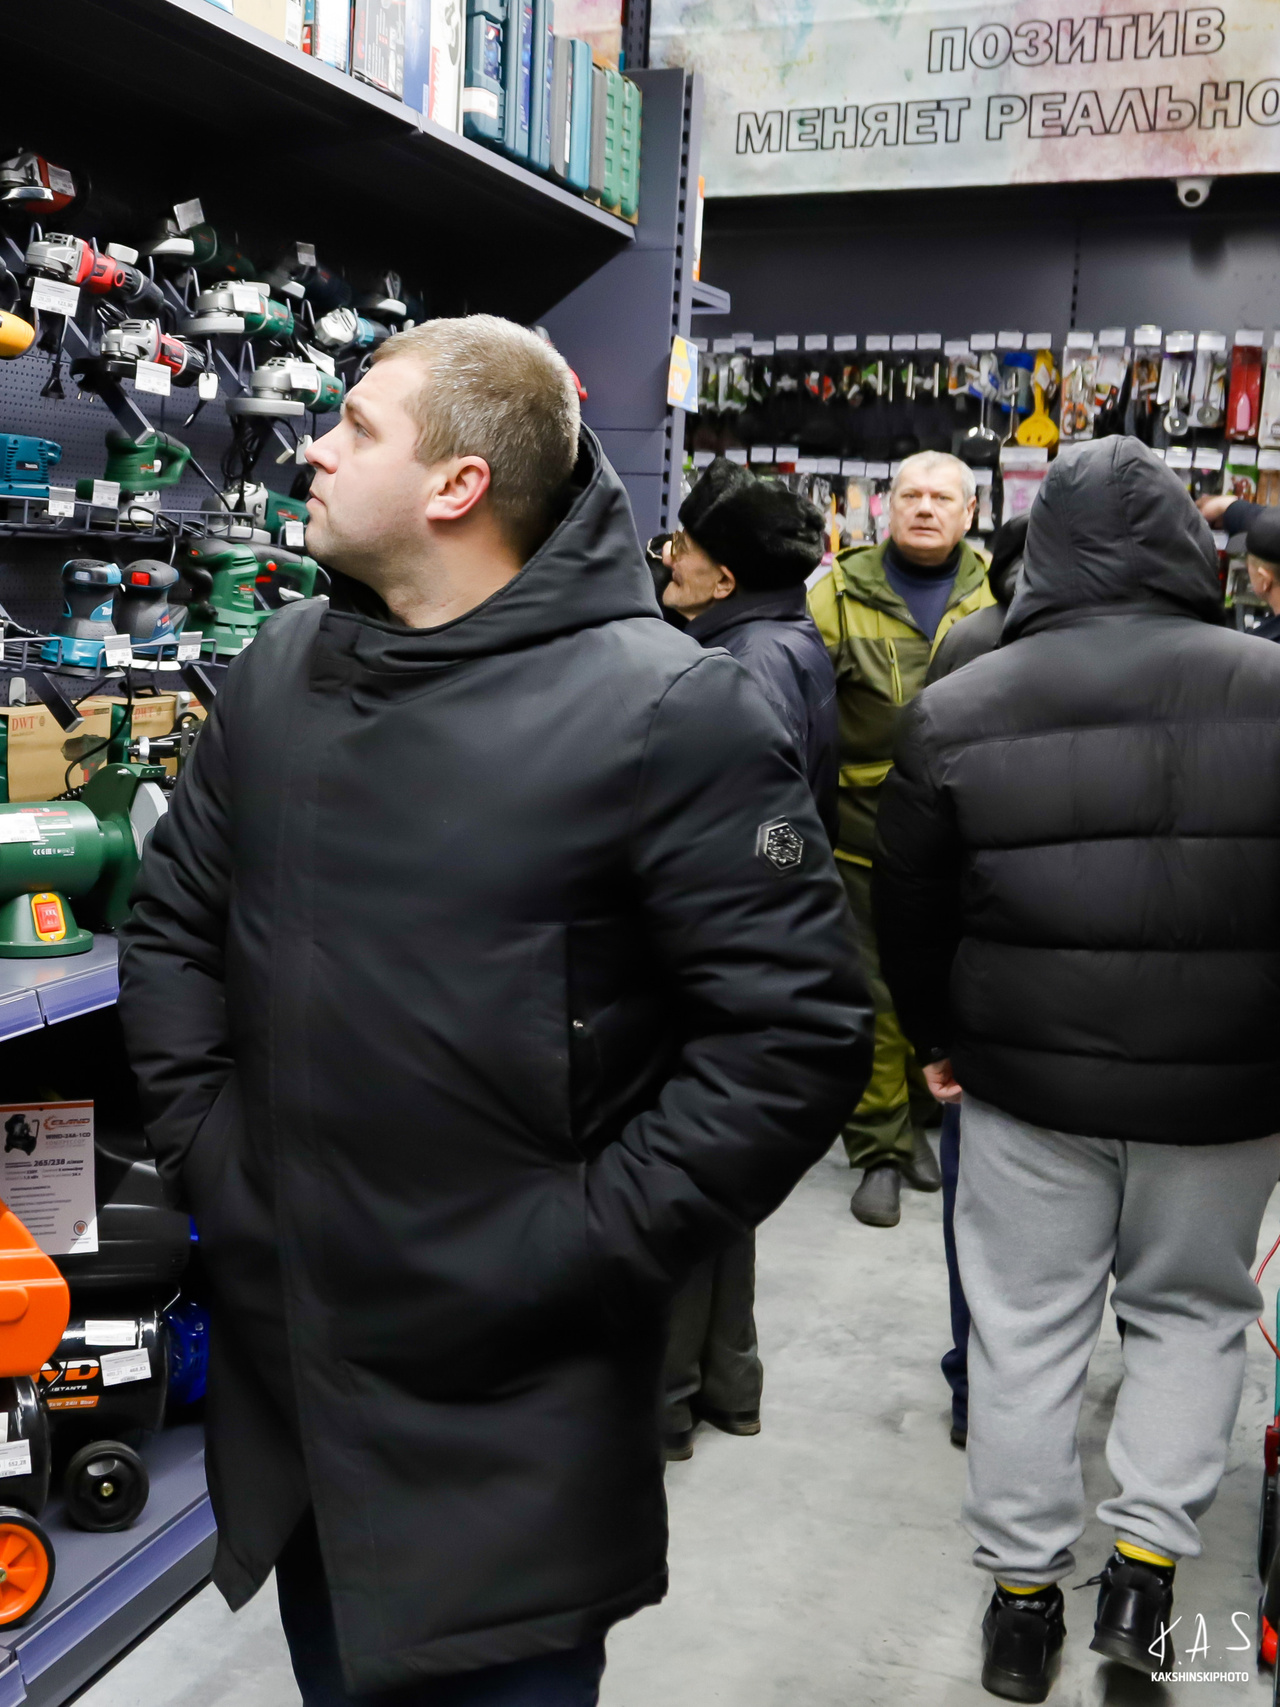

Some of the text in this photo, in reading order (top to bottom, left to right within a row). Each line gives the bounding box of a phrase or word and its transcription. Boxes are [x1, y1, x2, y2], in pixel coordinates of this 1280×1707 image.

[928, 8, 1226, 73] ПОЗИТИВ
[736, 79, 1280, 155] МЕНЯЕТ РЕАЛЬНО
[12, 715, 36, 732] DWT
